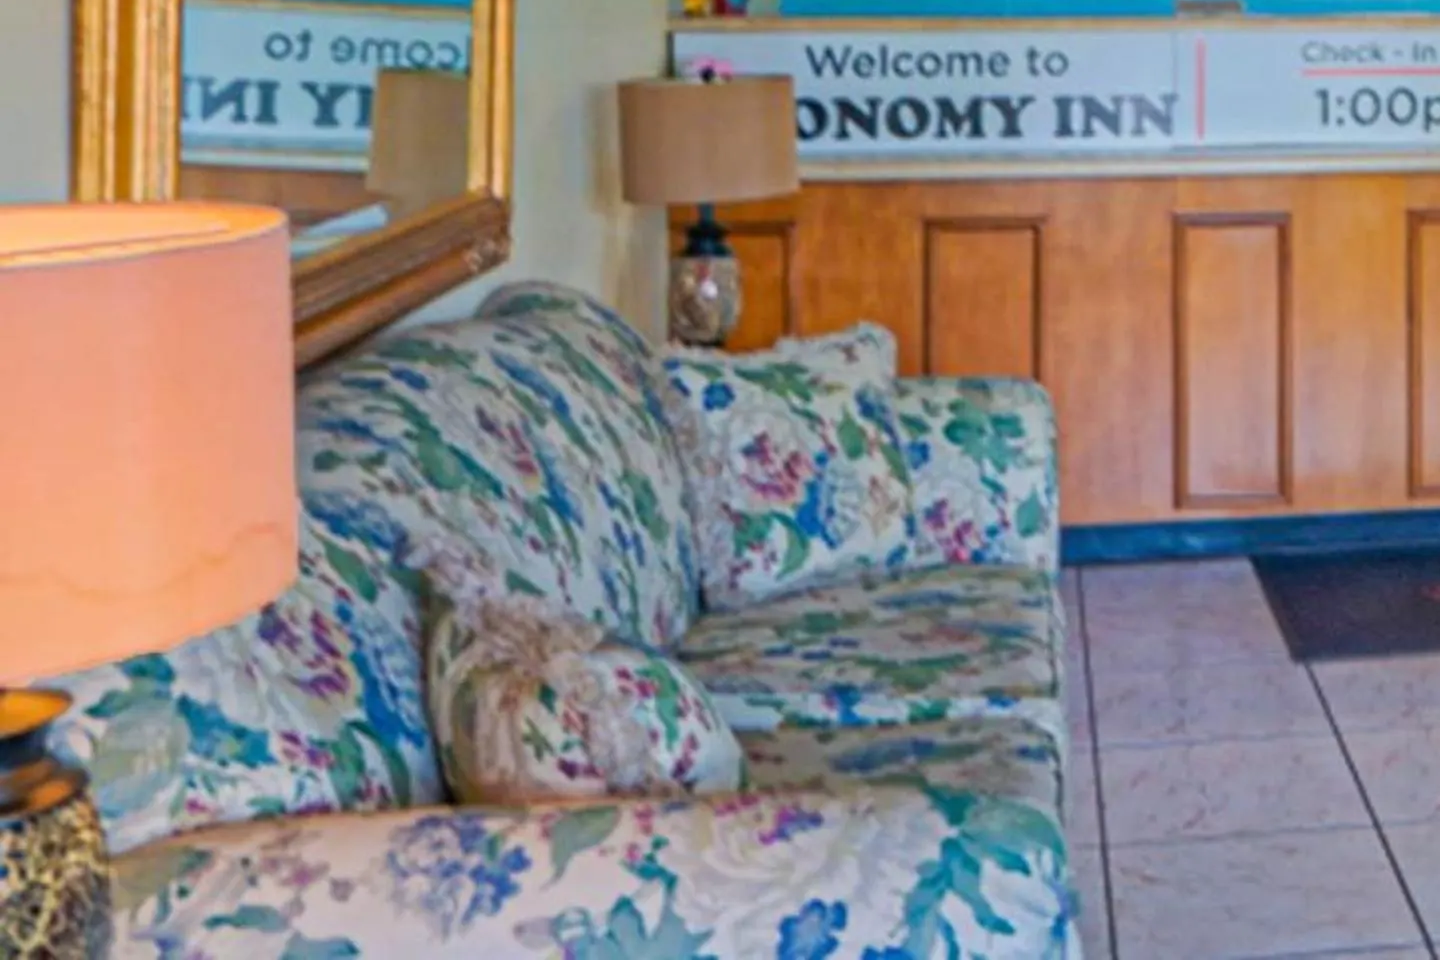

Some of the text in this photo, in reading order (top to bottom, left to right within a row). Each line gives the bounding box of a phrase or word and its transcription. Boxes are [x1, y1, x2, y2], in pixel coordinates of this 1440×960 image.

[804, 44, 1069, 78] Welcome to
[1302, 43, 1384, 64] Check
[1413, 43, 1438, 63] In
[1054, 94, 1178, 139] INN
